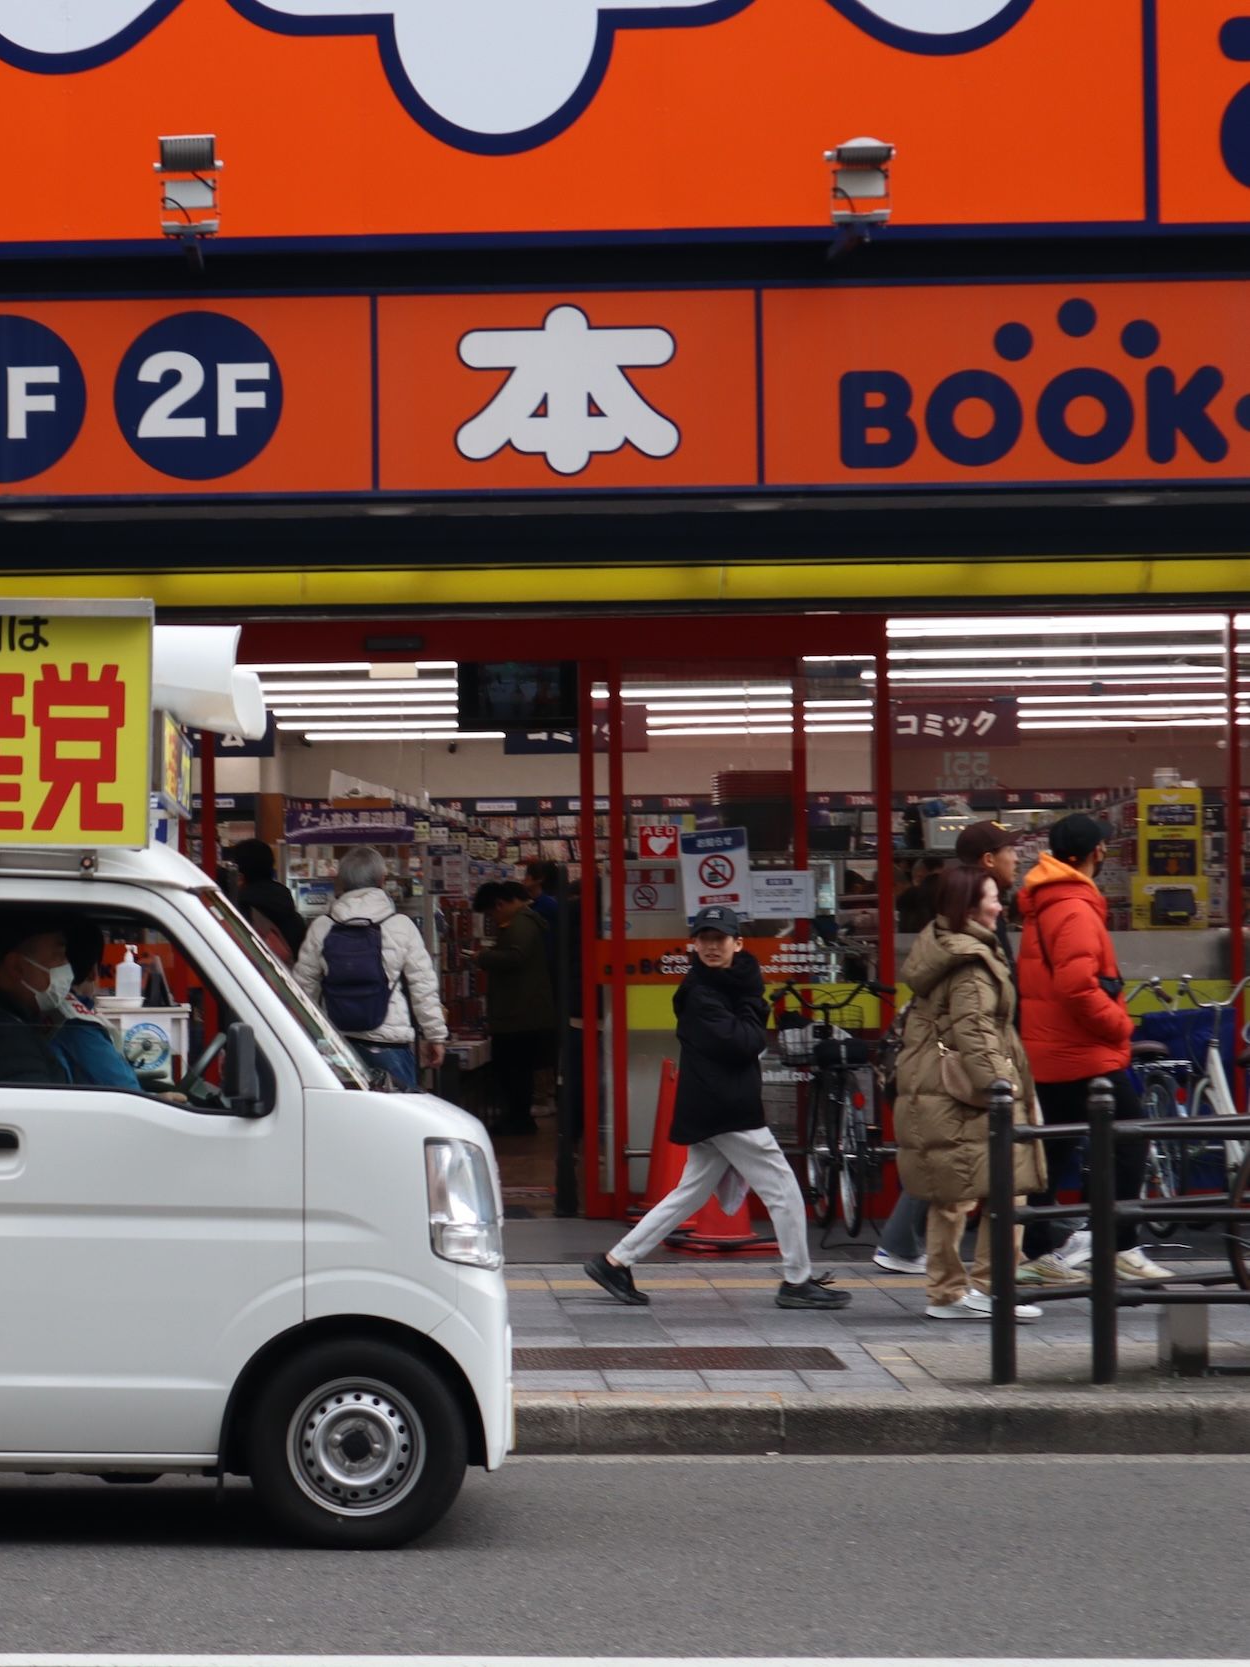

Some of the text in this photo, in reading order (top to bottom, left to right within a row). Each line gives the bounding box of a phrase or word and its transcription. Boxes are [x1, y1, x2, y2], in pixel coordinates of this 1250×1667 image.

[137, 350, 271, 438] 2F
[457, 304, 681, 475] 本
[896, 710, 998, 738] コミック
[642, 826, 676, 836] AED
